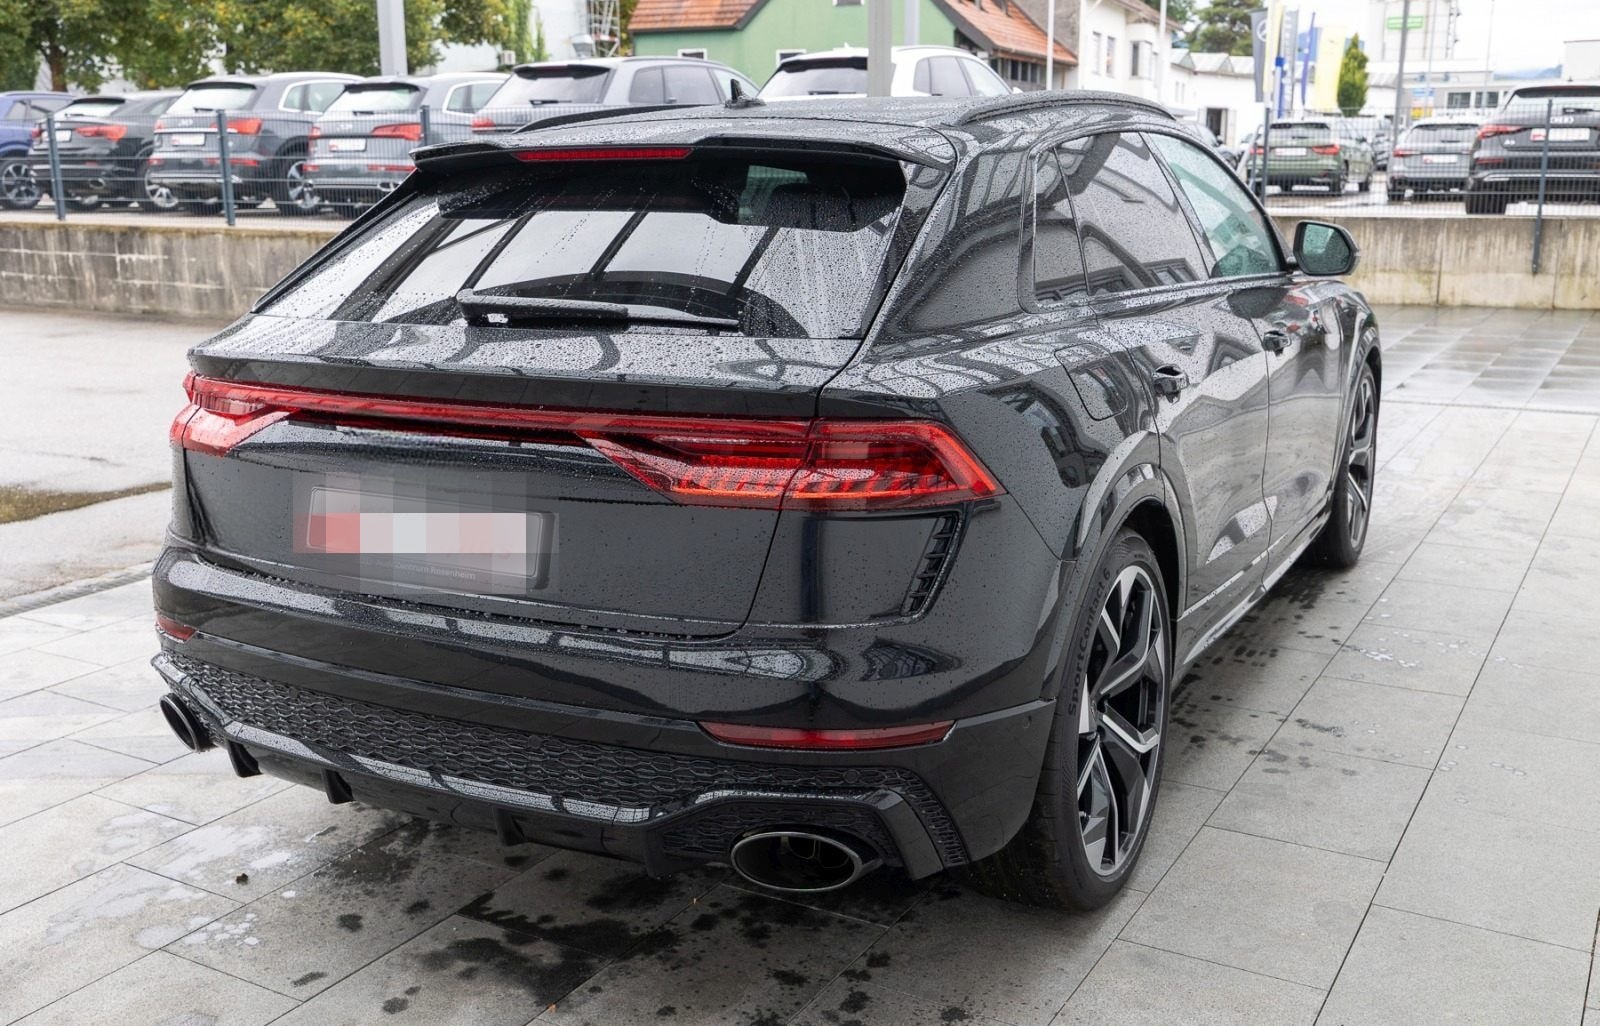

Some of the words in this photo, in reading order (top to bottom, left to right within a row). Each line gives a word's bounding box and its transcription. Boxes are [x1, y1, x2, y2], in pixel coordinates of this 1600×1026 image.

[394, 561, 429, 573] Zentrum
[430, 566, 475, 580] Rosenheim
[1069, 581, 1106, 716] SportContact
[1103, 567, 1111, 580] 6
